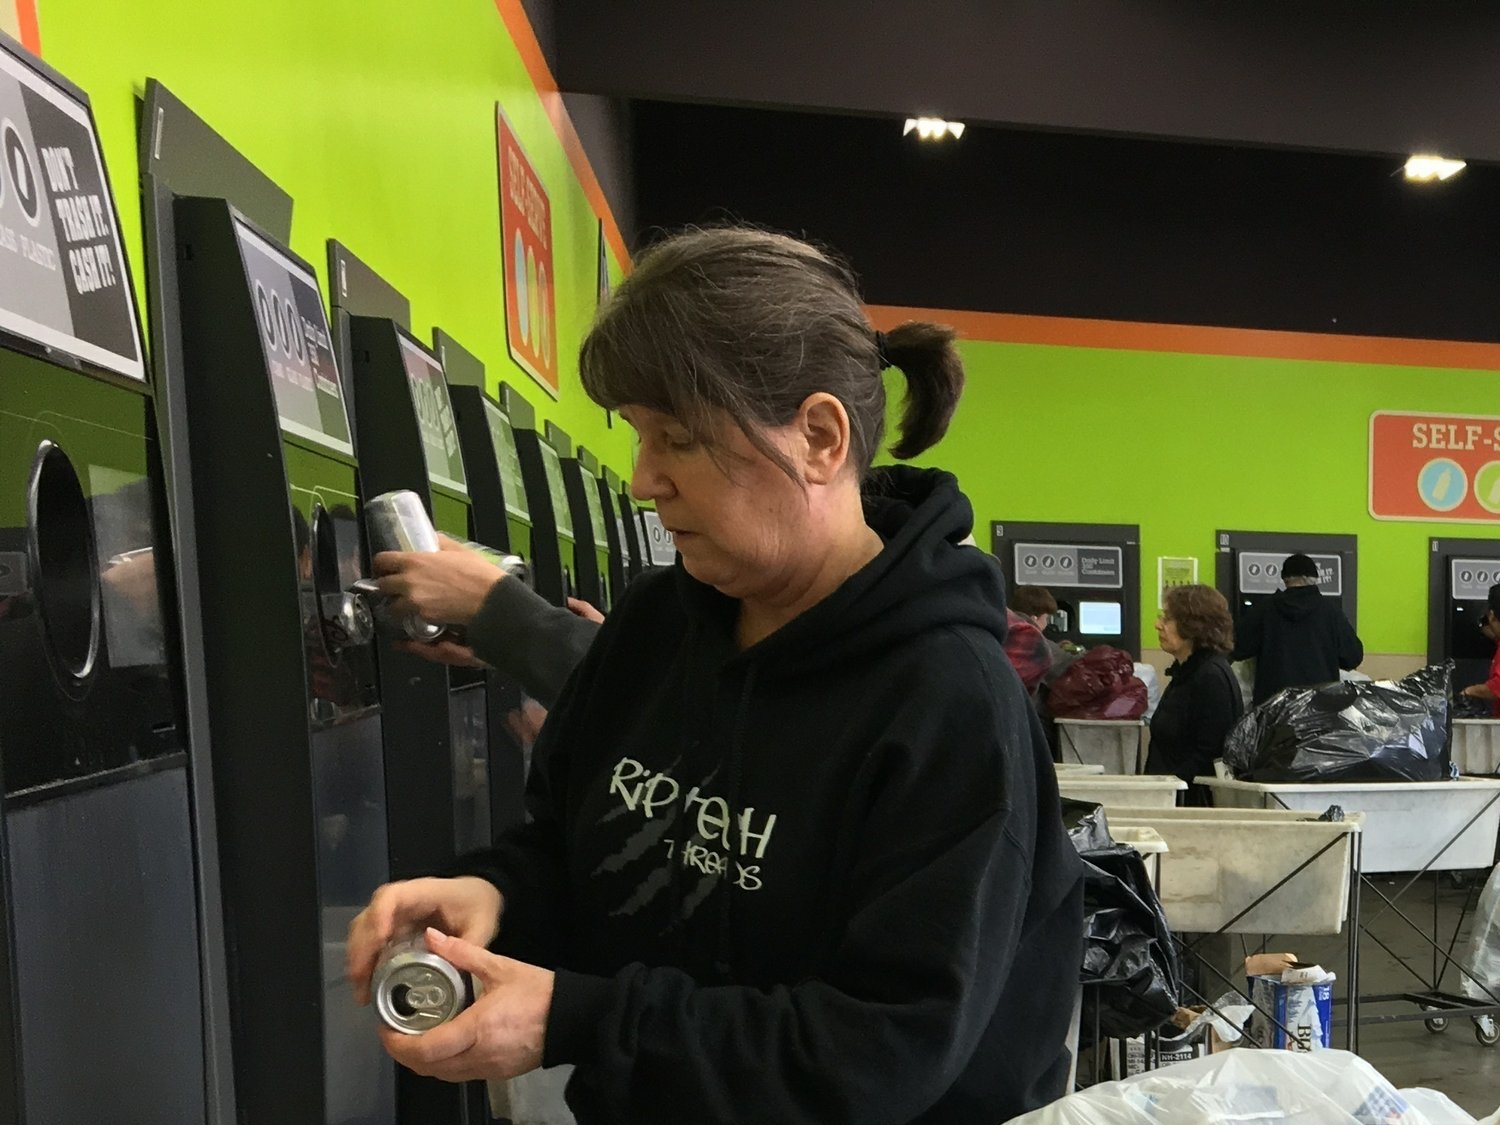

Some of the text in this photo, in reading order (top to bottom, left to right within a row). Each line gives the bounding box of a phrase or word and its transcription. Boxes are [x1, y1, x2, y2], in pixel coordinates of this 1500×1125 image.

[41, 146, 79, 192] DON'T
[55, 195, 97, 242] TRASH
[69, 247, 102, 295] CASH
